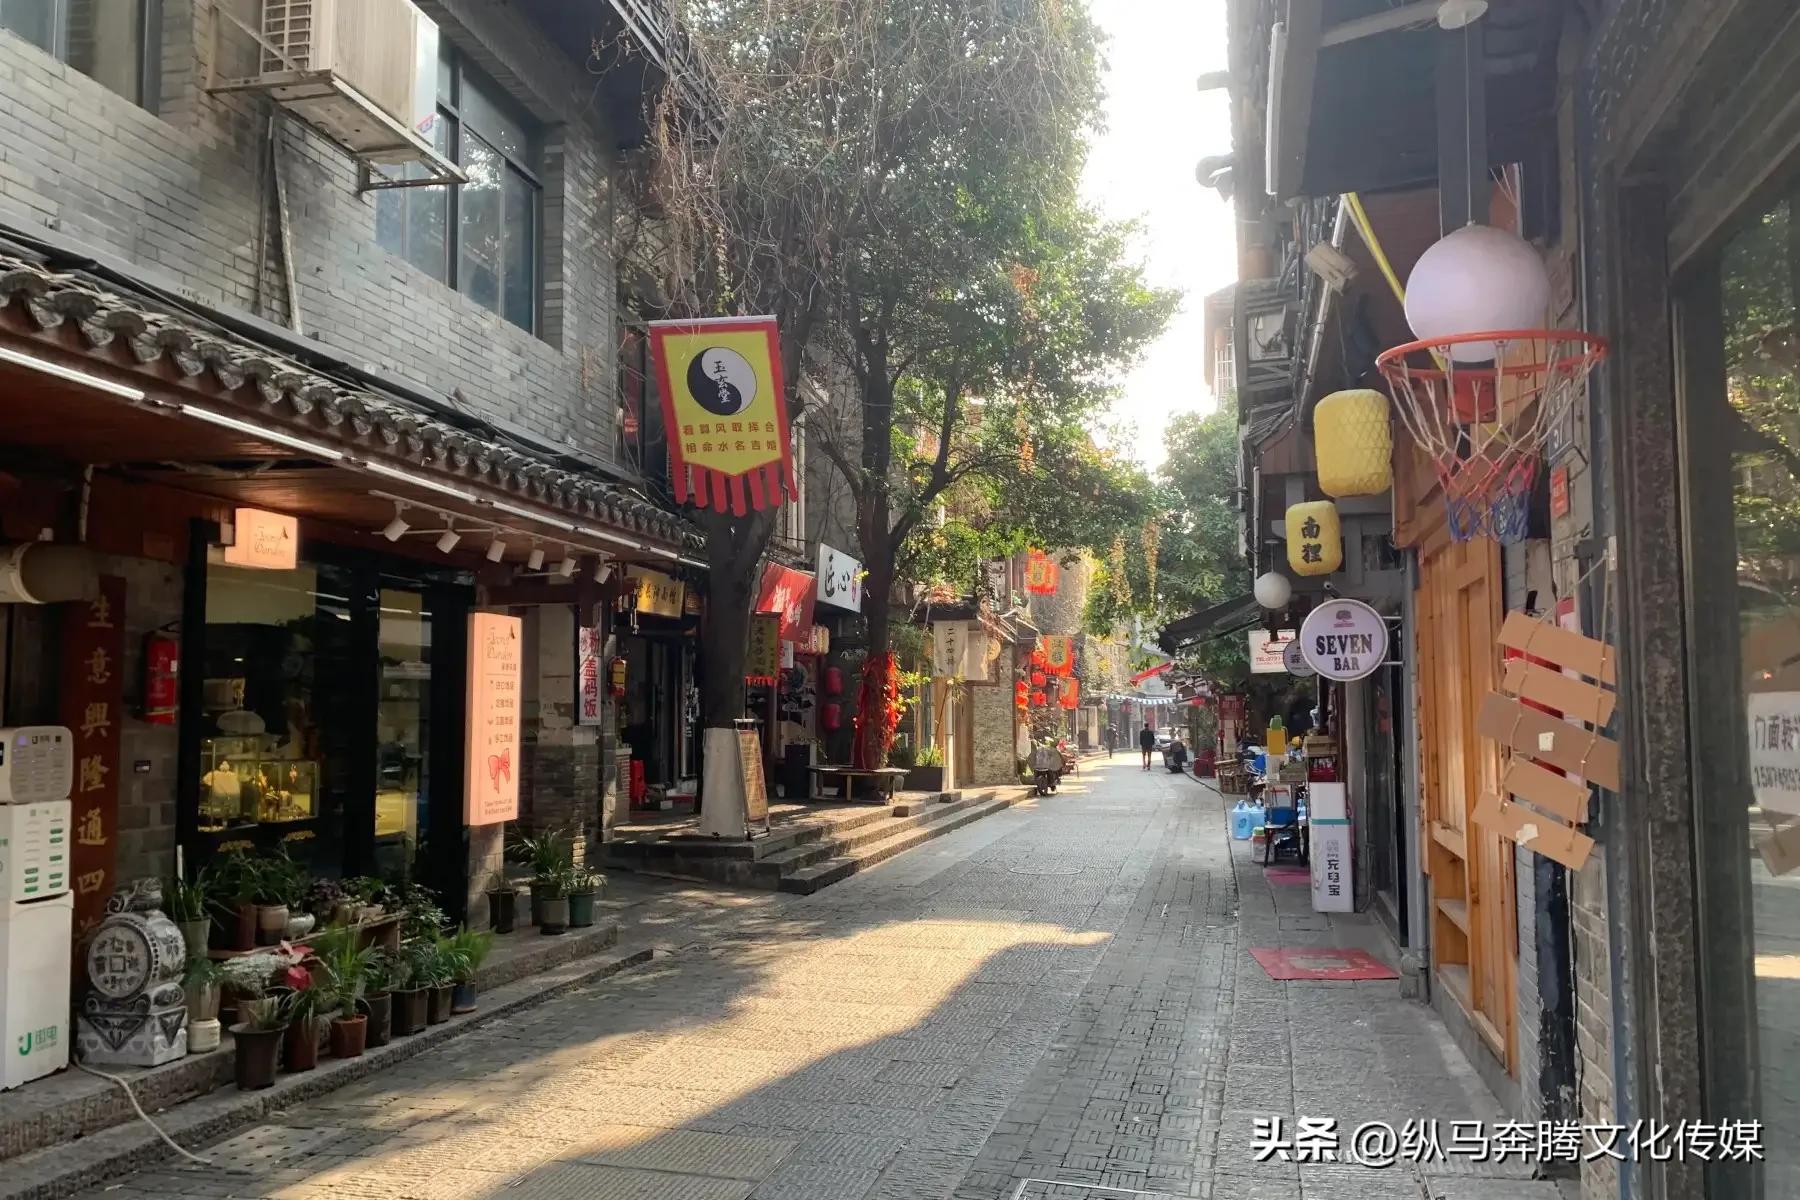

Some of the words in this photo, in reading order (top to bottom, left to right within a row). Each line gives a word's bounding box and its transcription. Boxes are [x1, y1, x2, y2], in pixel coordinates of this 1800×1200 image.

[823, 553, 851, 598] 匠心
[1315, 633, 1373, 656] SEVEN
[1333, 656, 1360, 672] BAR
[583, 657, 598, 718] 盖码饭
[1326, 859, 1341, 897] 充电宝
